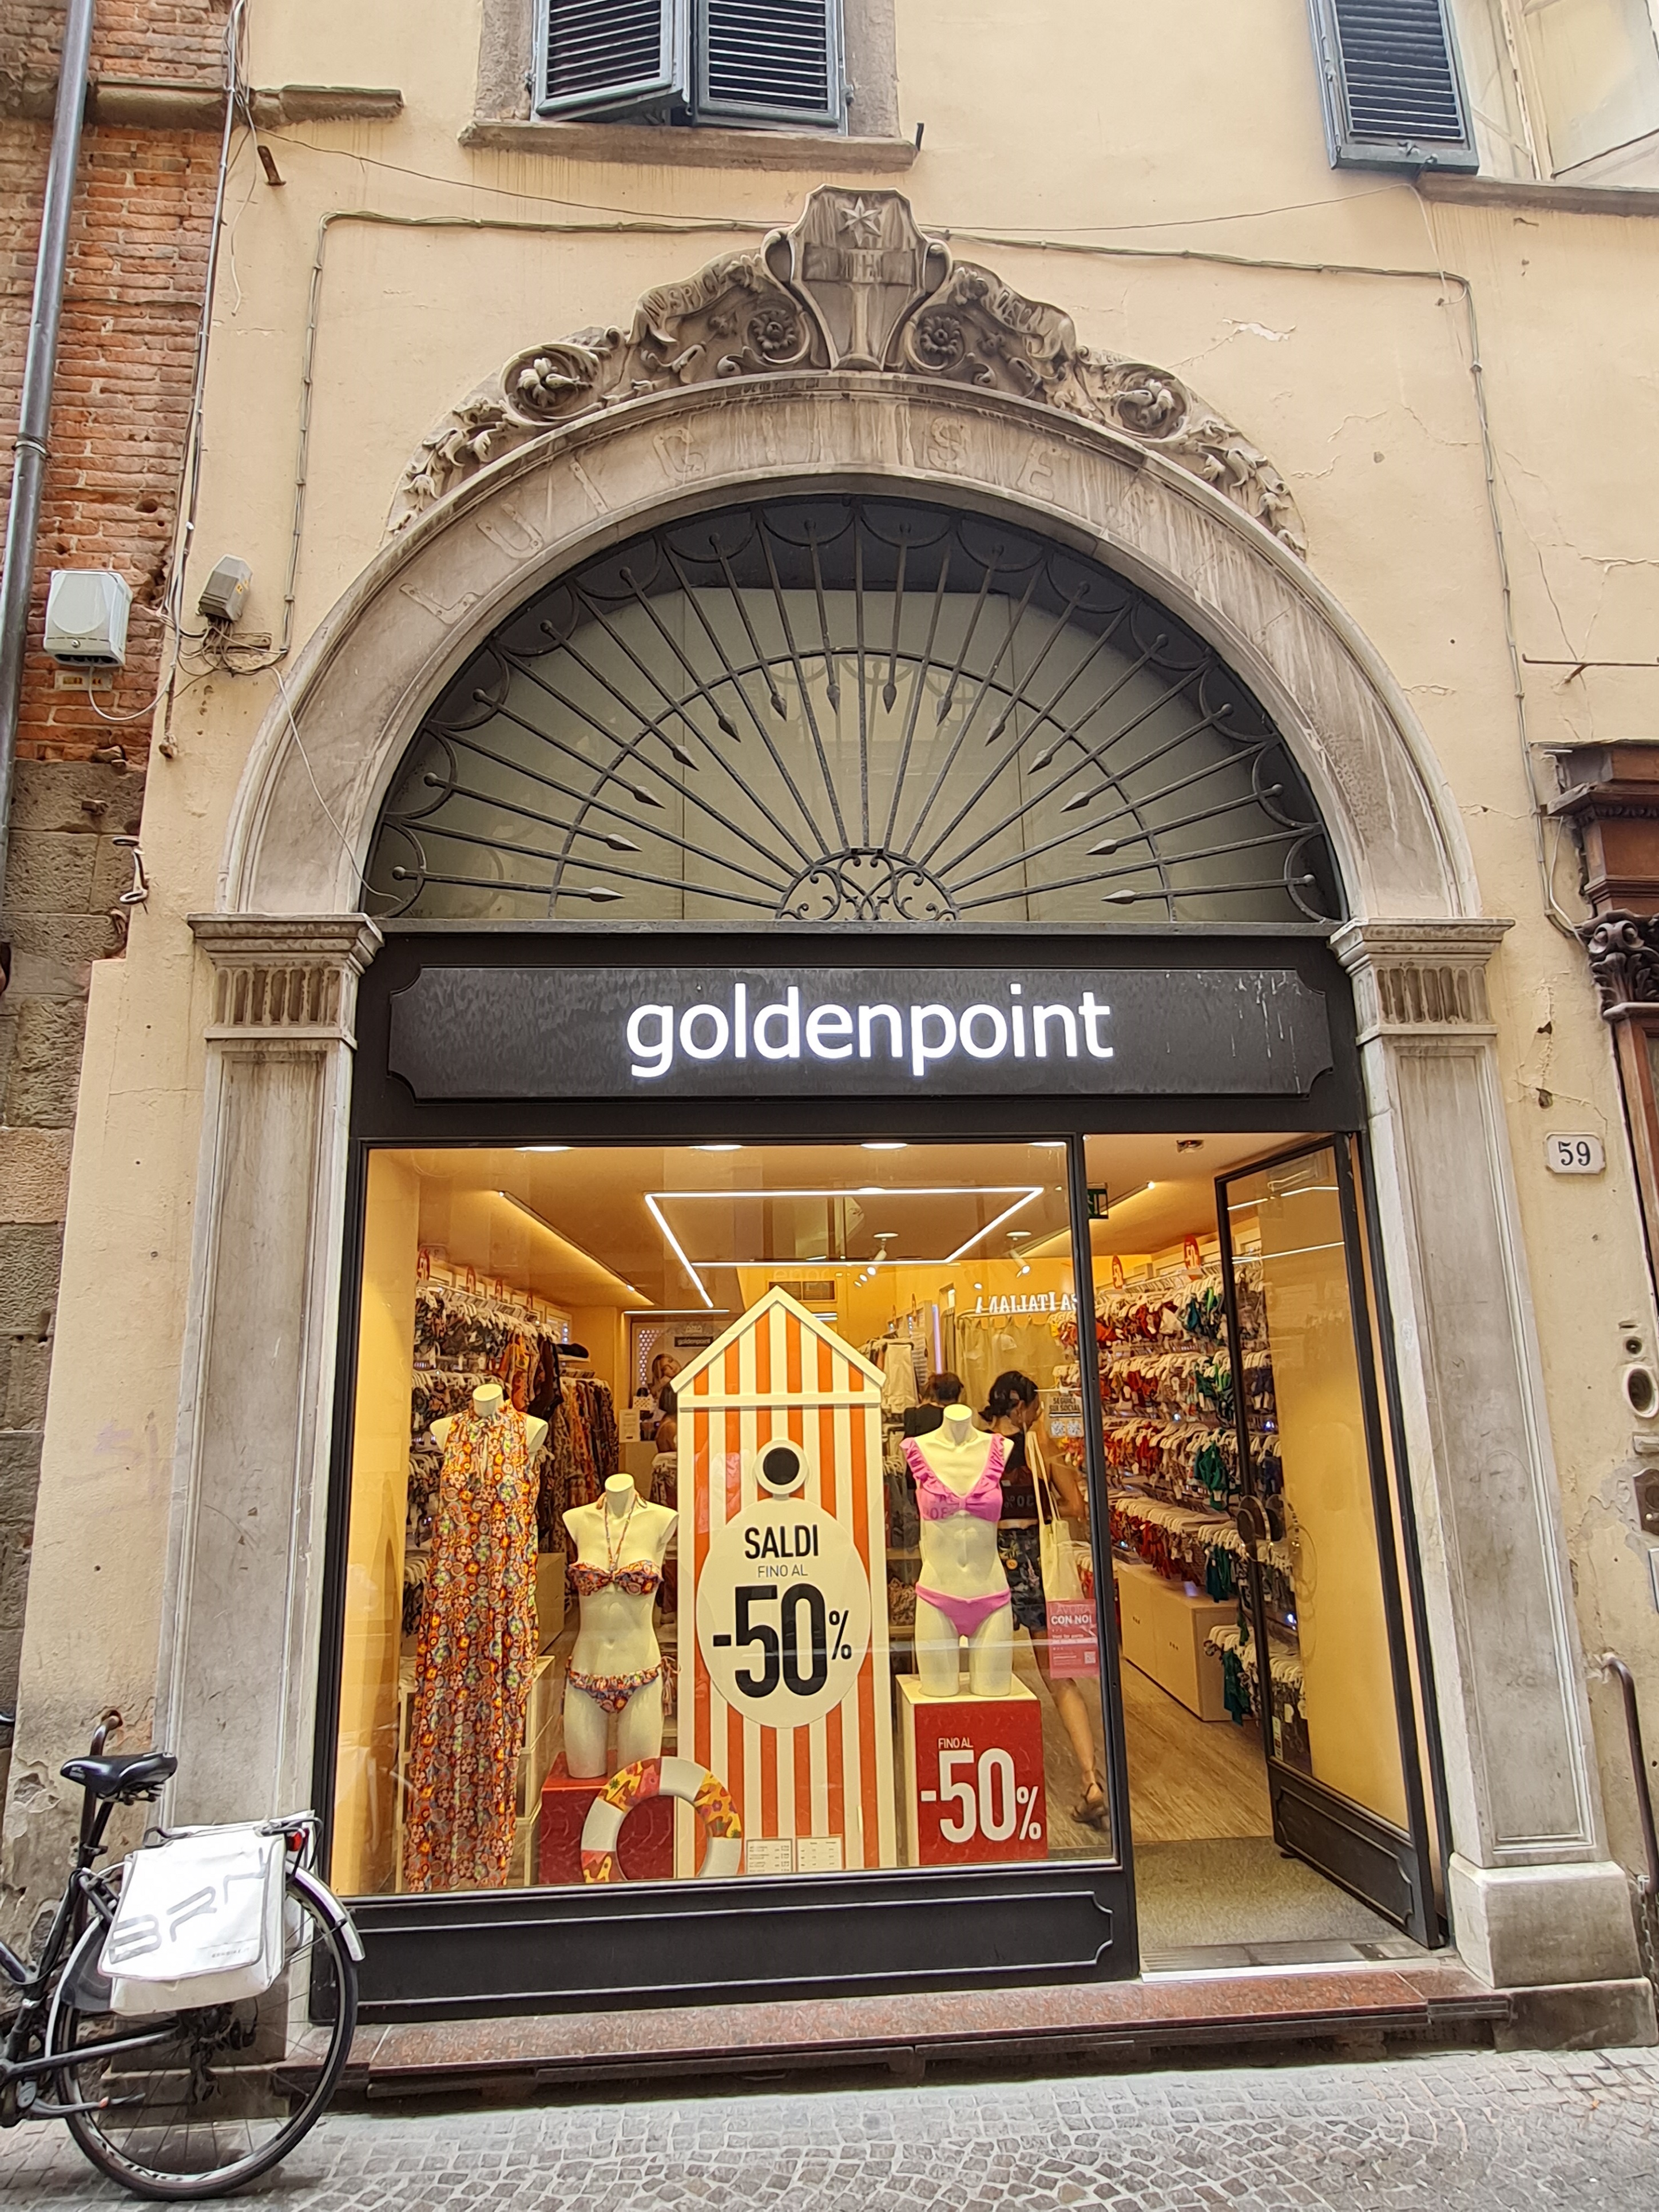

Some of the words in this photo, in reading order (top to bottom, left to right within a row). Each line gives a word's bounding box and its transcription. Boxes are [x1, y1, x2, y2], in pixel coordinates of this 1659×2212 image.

[626, 982, 1113, 1077] goldenpoint
[1558, 1141, 1591, 1166] 59
[745, 1524, 819, 1559] SALDI
[757, 1565, 788, 1577] FINO
[792, 1564, 808, 1576] AL
[1051, 1615, 1073, 1625] CON
[1074, 1614, 1092, 1624] NOI
[713, 1583, 852, 1698] -50%
[938, 1737, 960, 1749] FINO
[961, 1737, 974, 1748] AL
[921, 1748, 1041, 1843] -50%
